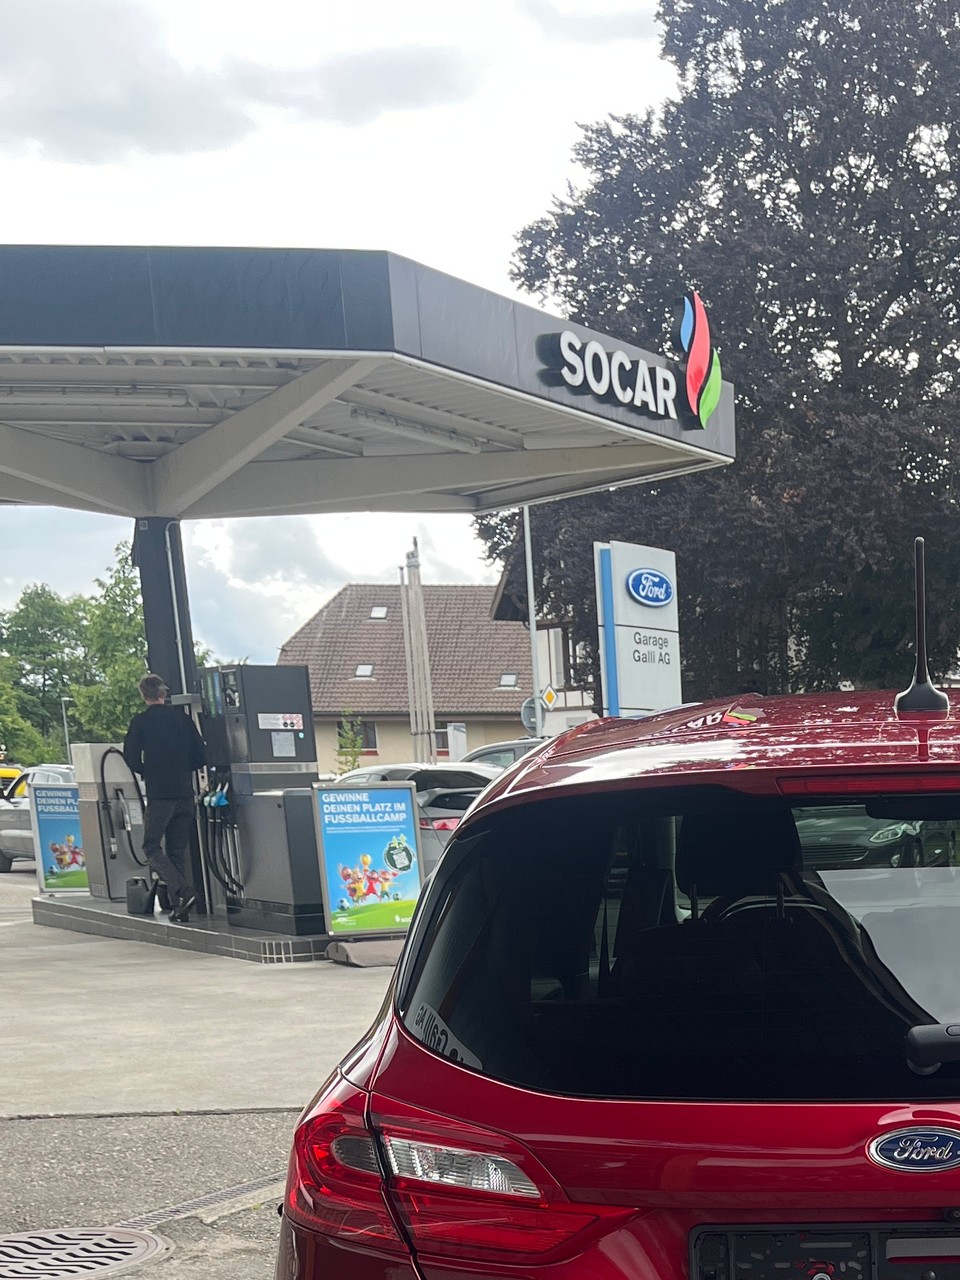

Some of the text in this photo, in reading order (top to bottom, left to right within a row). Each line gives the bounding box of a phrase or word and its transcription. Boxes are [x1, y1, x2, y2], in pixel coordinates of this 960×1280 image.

[560, 330, 678, 420] SOCAR
[639, 574, 667, 600] Ford
[633, 631, 669, 650] Garage
[632, 649, 671, 665] Galli AG
[321, 792, 369, 802] GEWINNE
[323, 802, 406, 813] DEINEN PLATZ IM
[324, 812, 407, 824] FUSSBALLCAMP
[893, 1135, 955, 1161] Ford
